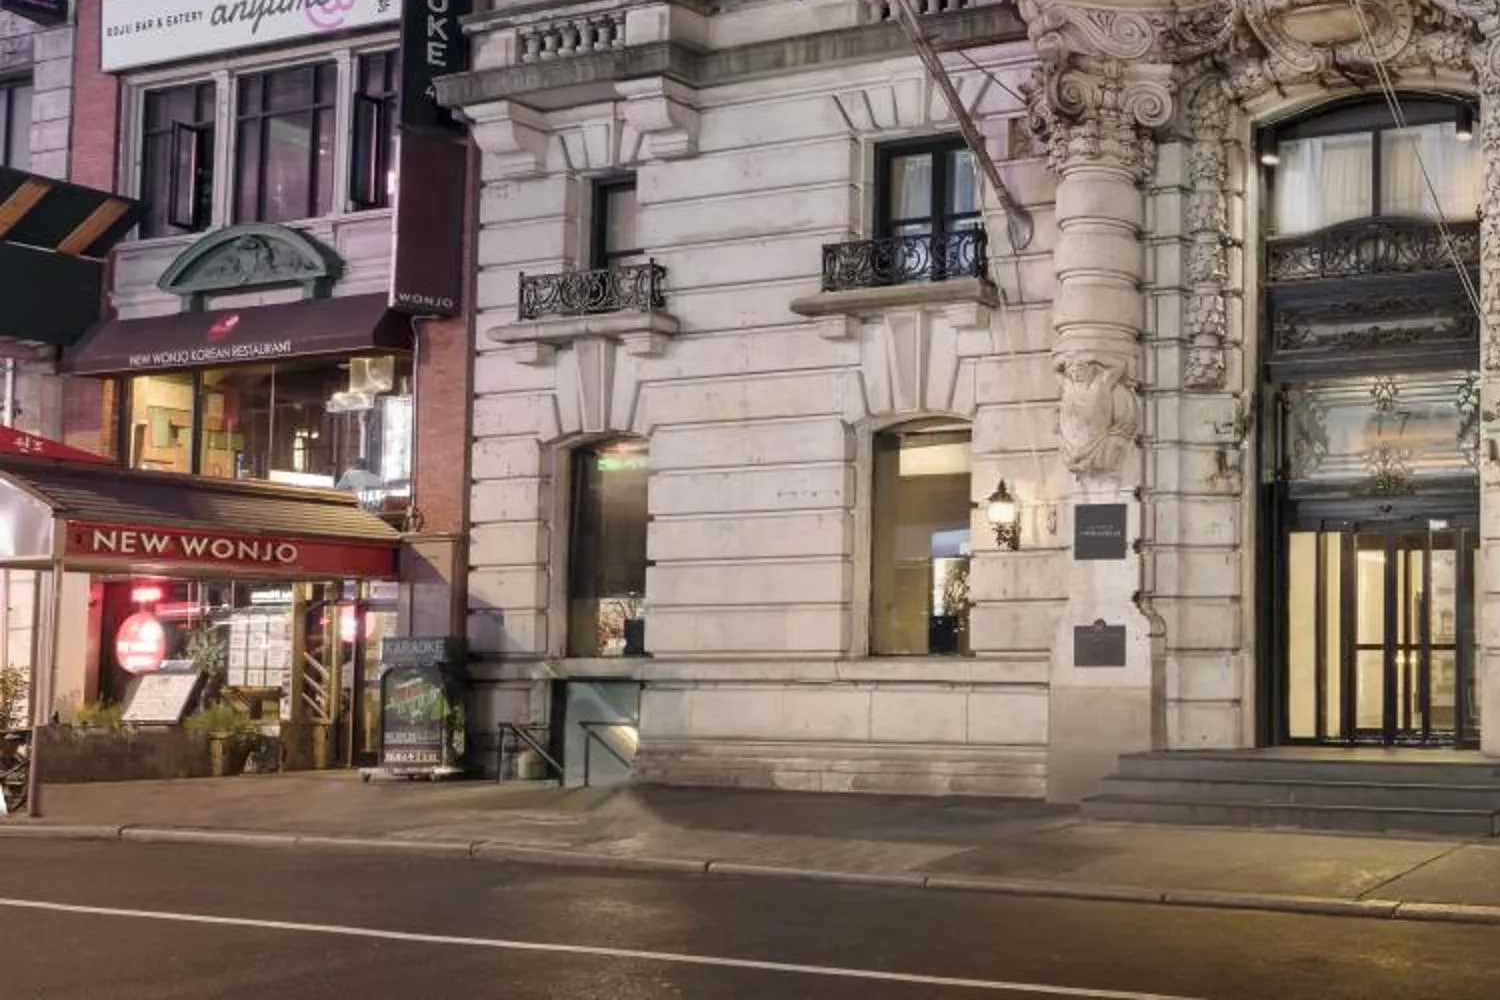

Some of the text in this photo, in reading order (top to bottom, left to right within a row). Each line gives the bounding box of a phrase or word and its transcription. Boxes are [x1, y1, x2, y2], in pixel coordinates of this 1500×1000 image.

[135, 20, 153, 33] BAR
[166, 10, 203, 27] EATERY
[400, 293, 453, 309] WONJO
[129, 340, 292, 367] NEW WONJO KOREAN RESTAURANT
[93, 529, 298, 563] NEW WONJO
